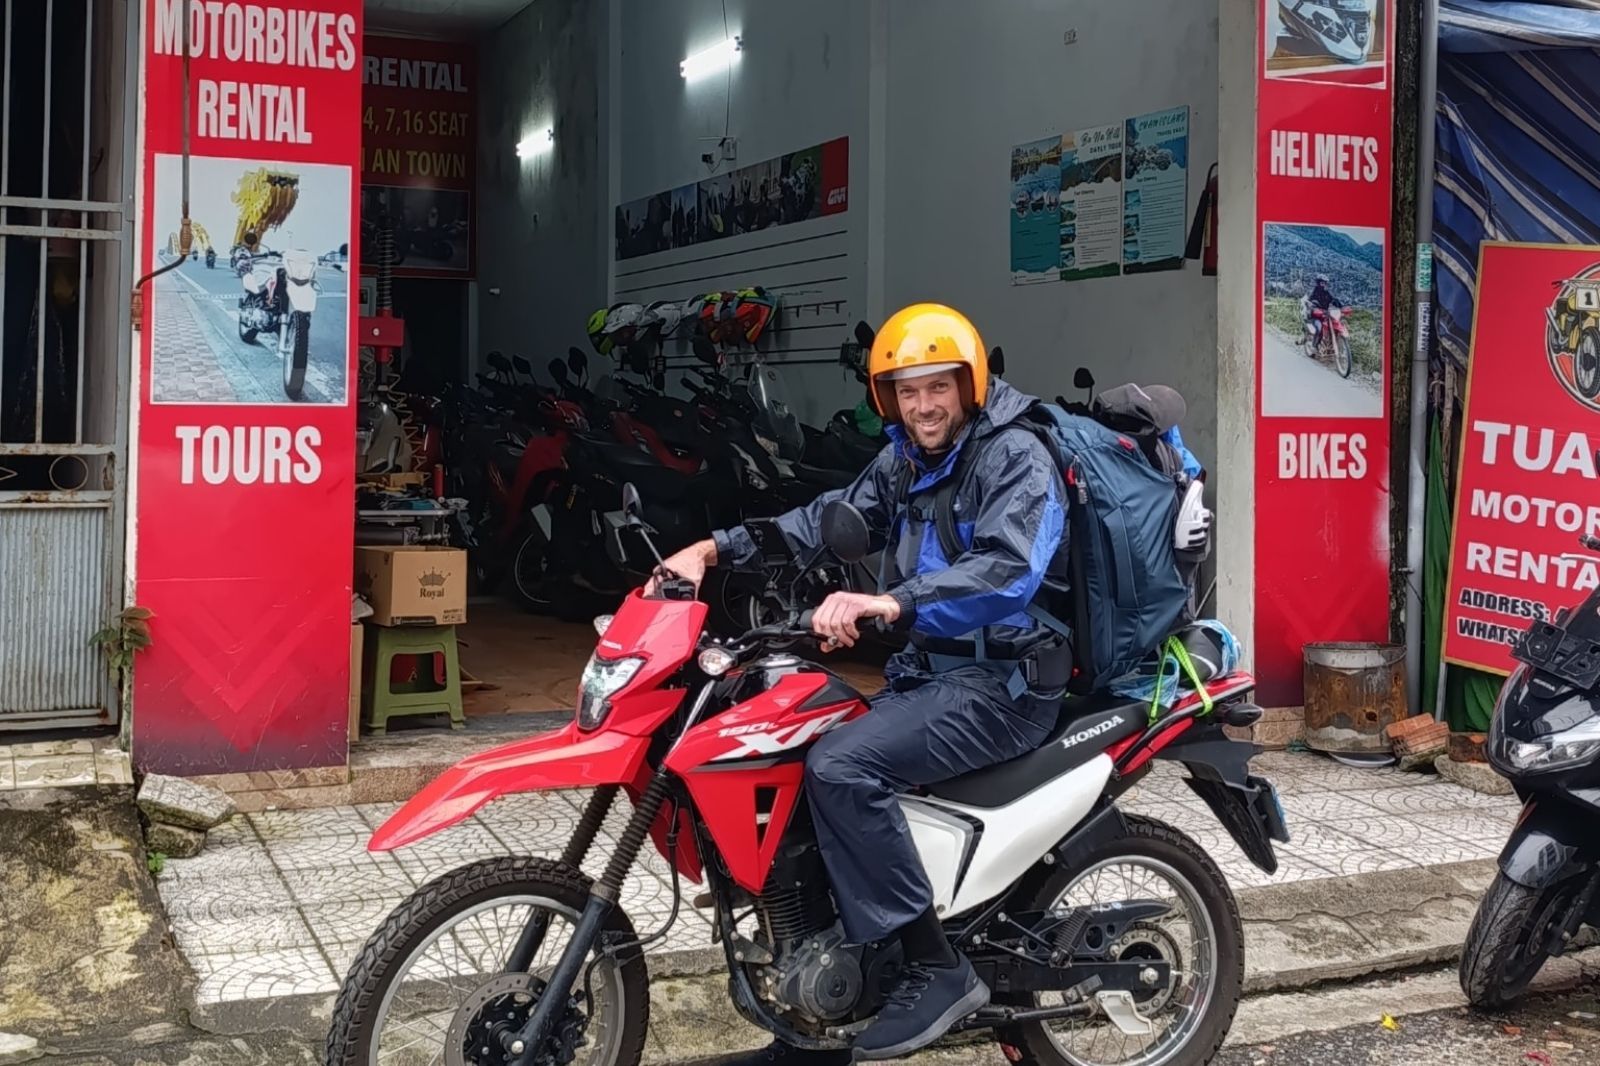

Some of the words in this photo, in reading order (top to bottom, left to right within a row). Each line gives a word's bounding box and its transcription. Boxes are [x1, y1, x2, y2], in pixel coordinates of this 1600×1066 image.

[154, 0, 356, 71] MOTORBIKES
[362, 55, 468, 93] RENTAL
[197, 79, 312, 144] RENTAL
[428, 110, 468, 137] SEAT
[372, 147, 400, 174] AN
[406, 150, 466, 178] TOWN
[1270, 129, 1378, 183] HELMETS
[175, 426, 322, 485] TOURS
[1278, 433, 1367, 479] BIKES
[419, 588, 444, 600] Royal
[1061, 715, 1125, 749] HONDA
